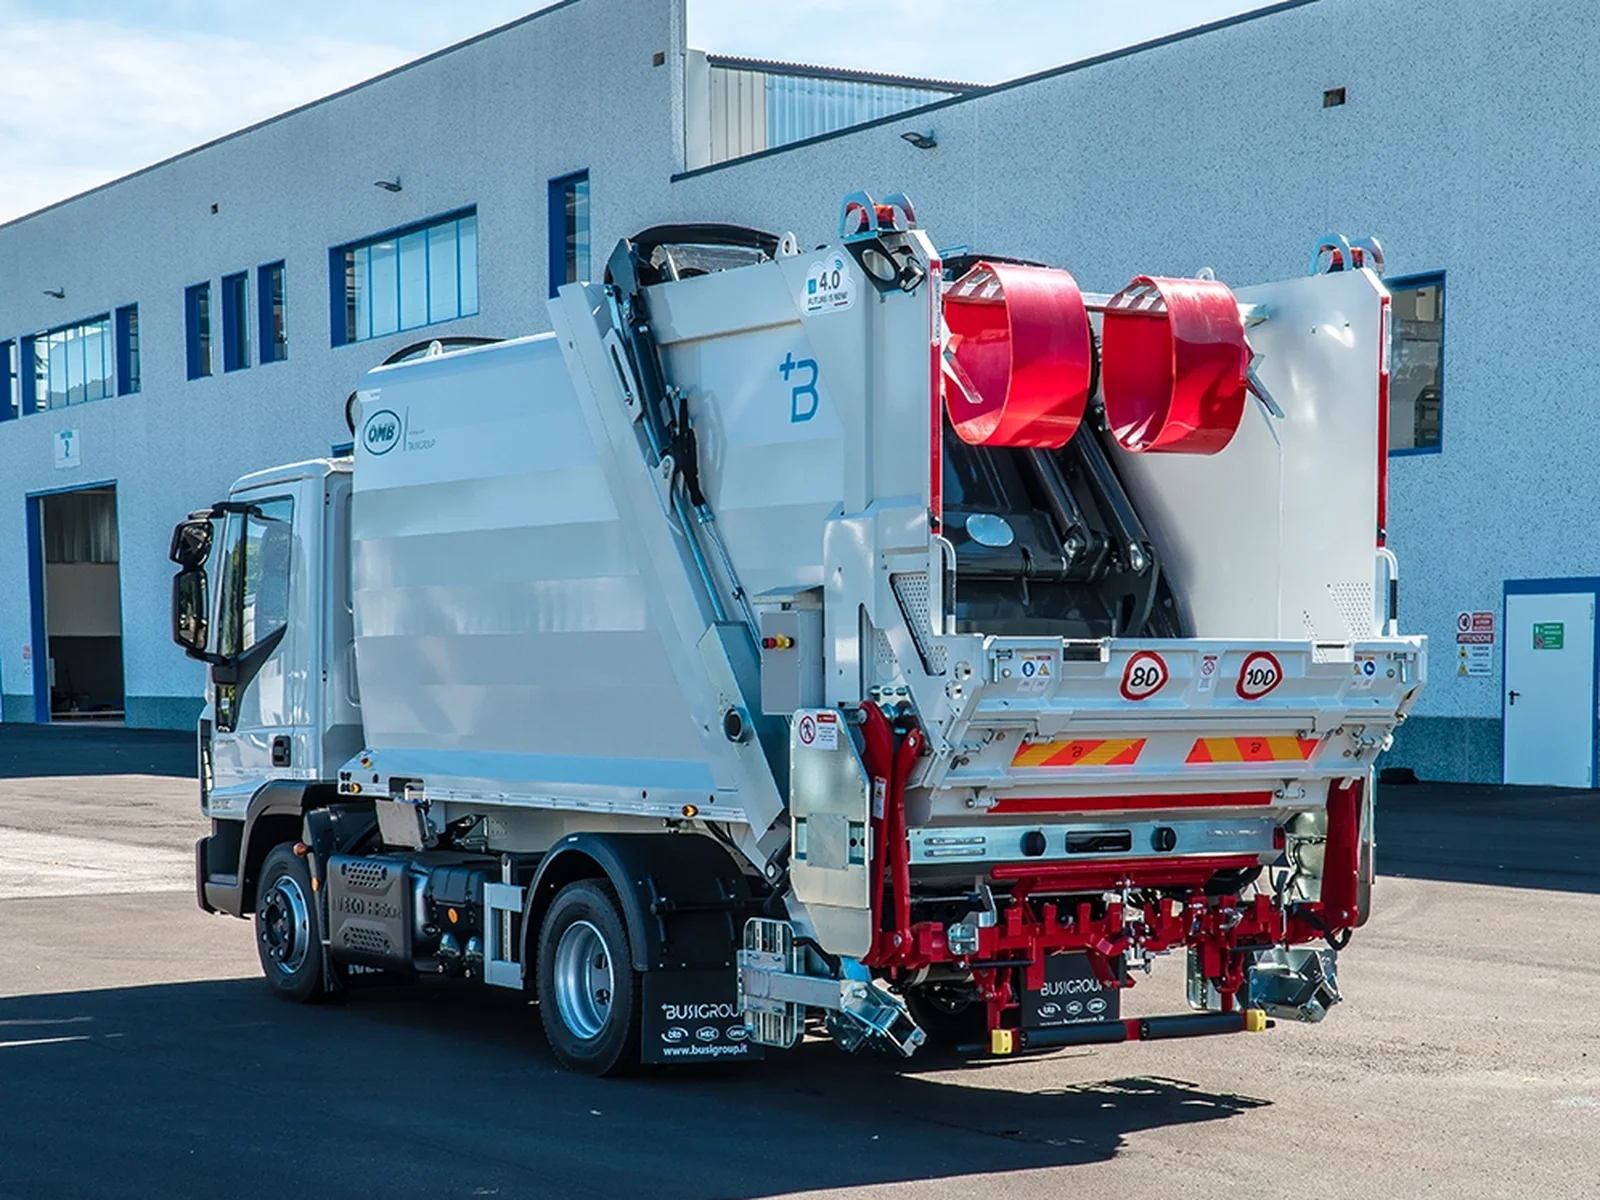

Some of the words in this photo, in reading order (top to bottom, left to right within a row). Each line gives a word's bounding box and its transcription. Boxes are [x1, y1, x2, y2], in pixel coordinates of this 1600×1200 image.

[819, 270, 841, 291] 4.0
[368, 422, 395, 443] OMB
[1130, 666, 1159, 687] 80
[1247, 668, 1275, 686] 100
[1040, 979, 1103, 997] BUSIGROU
[663, 1043, 748, 1056] www.busigroup.it
